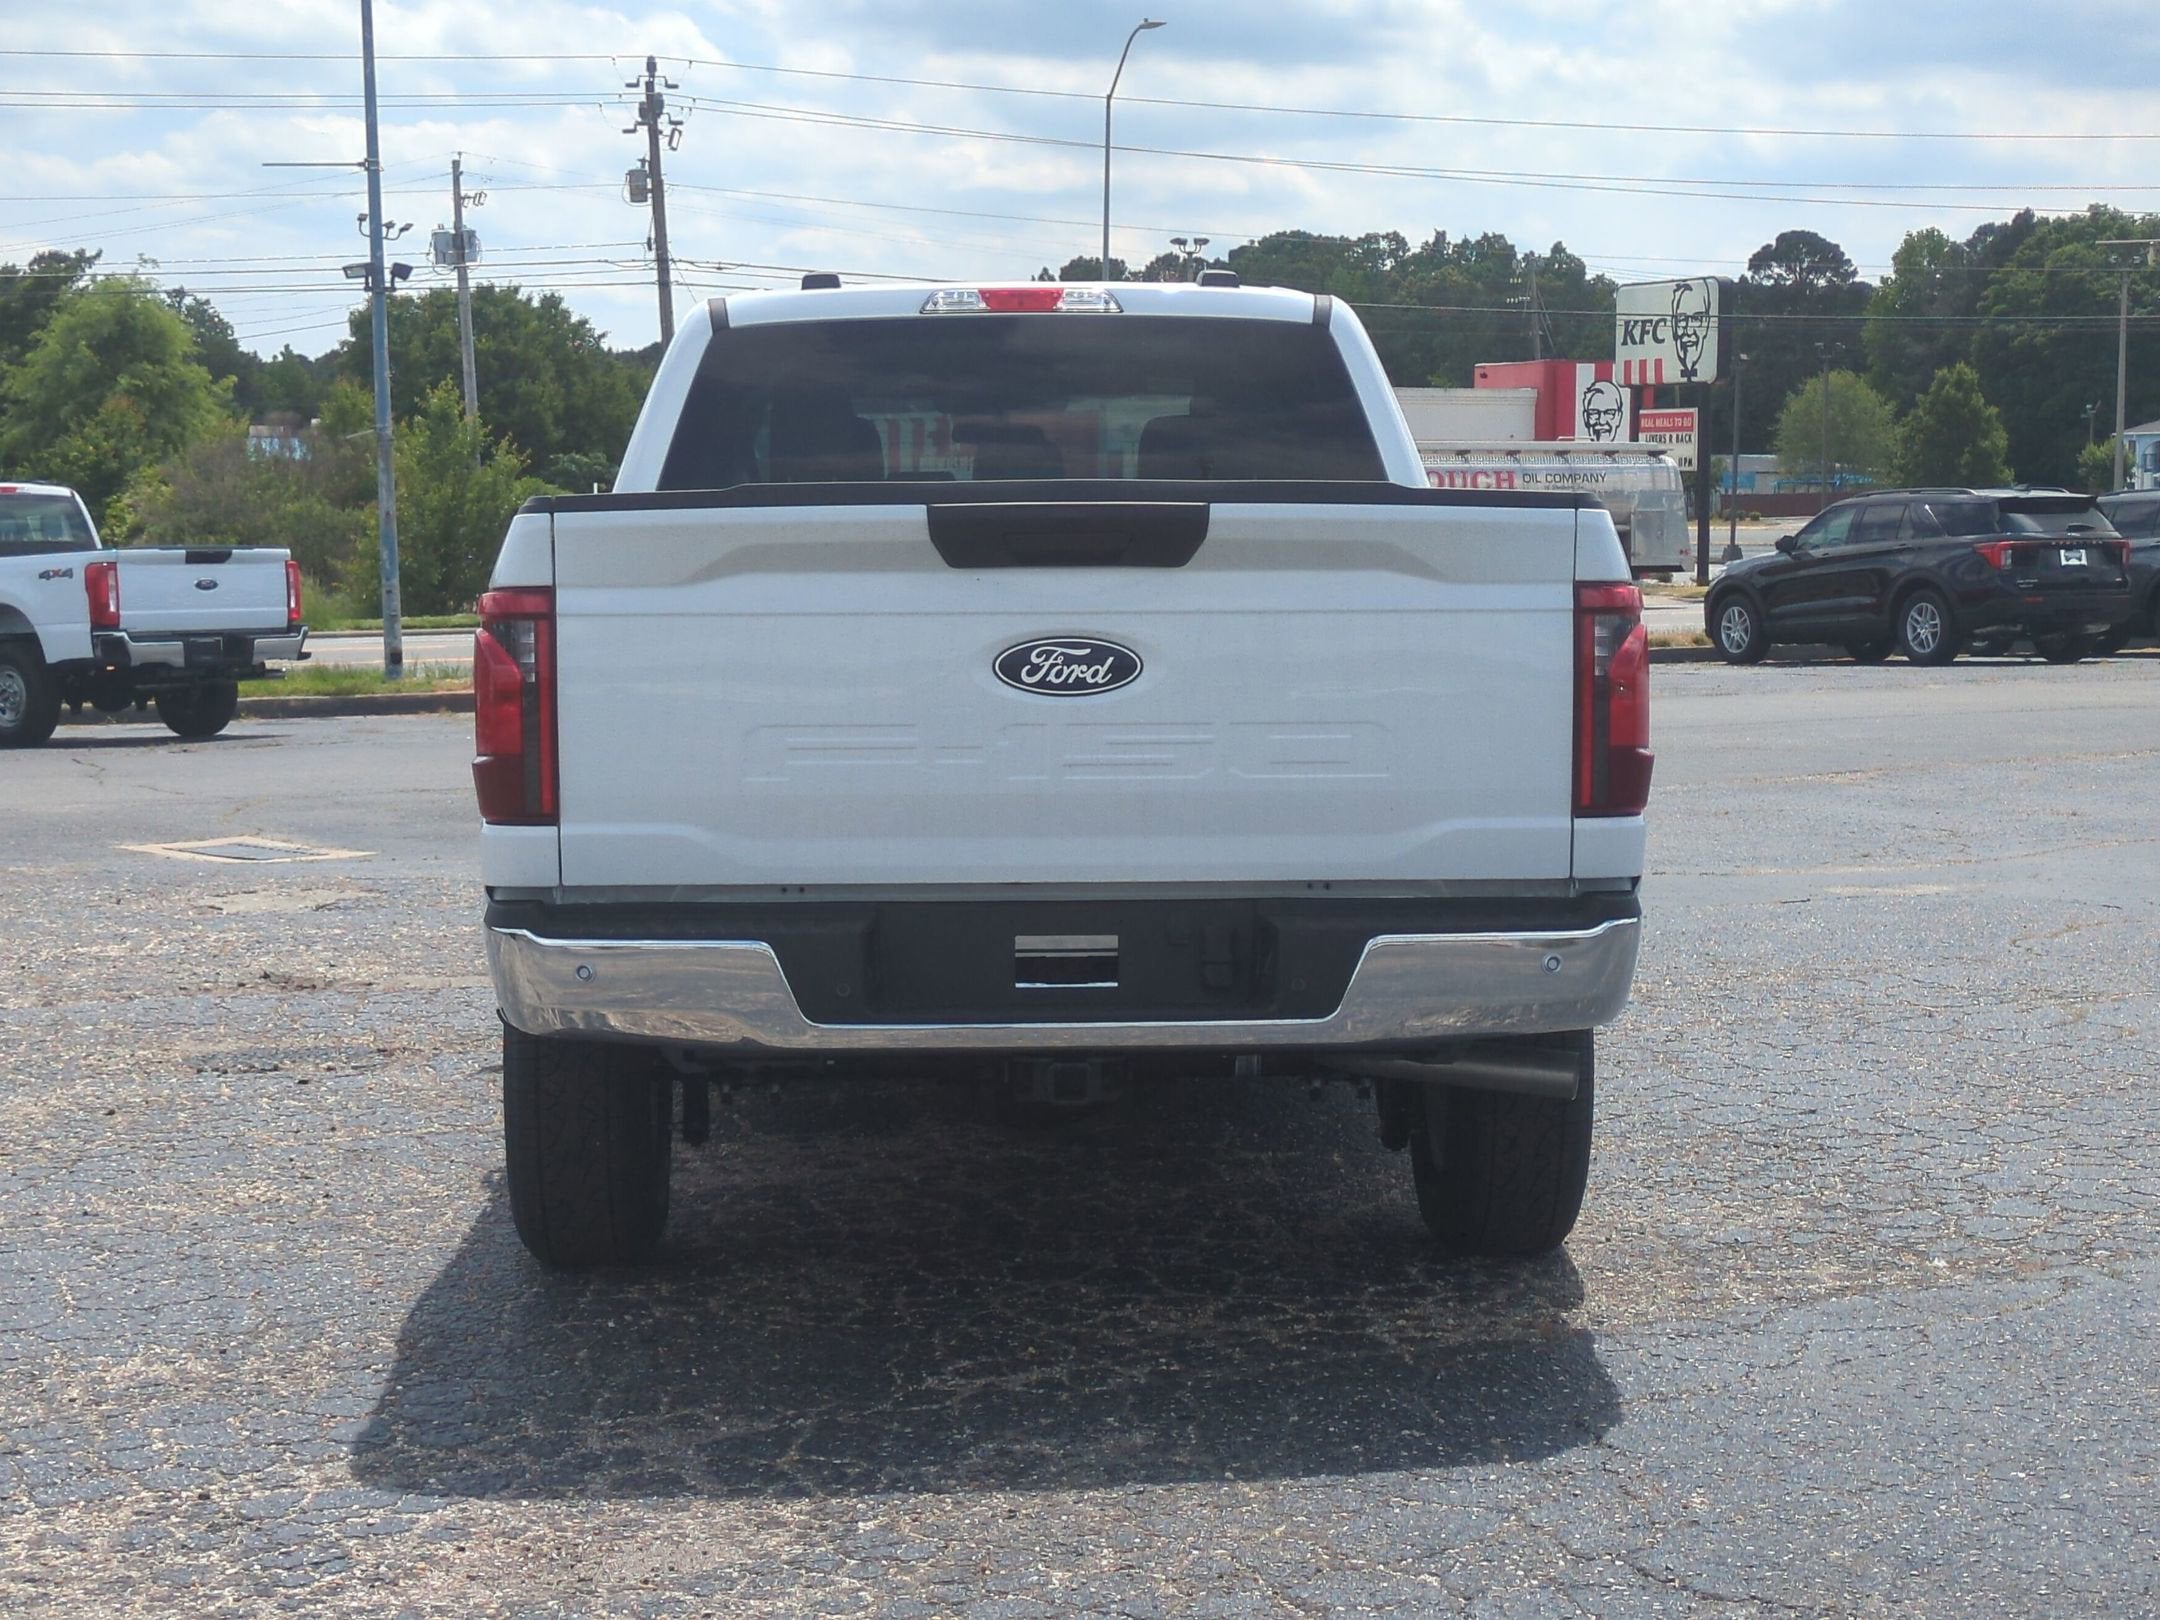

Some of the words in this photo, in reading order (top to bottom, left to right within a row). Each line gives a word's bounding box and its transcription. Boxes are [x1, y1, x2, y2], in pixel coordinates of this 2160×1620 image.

[1621, 318, 1667, 346] KFC
[1645, 433, 1667, 444] LIVERS
[1668, 434, 1673, 444] R
[1675, 433, 1692, 443] BACK
[1522, 472, 1542, 484] OIL
[1545, 472, 1607, 484] COMPANY
[1020, 646, 1115, 684] Ford
